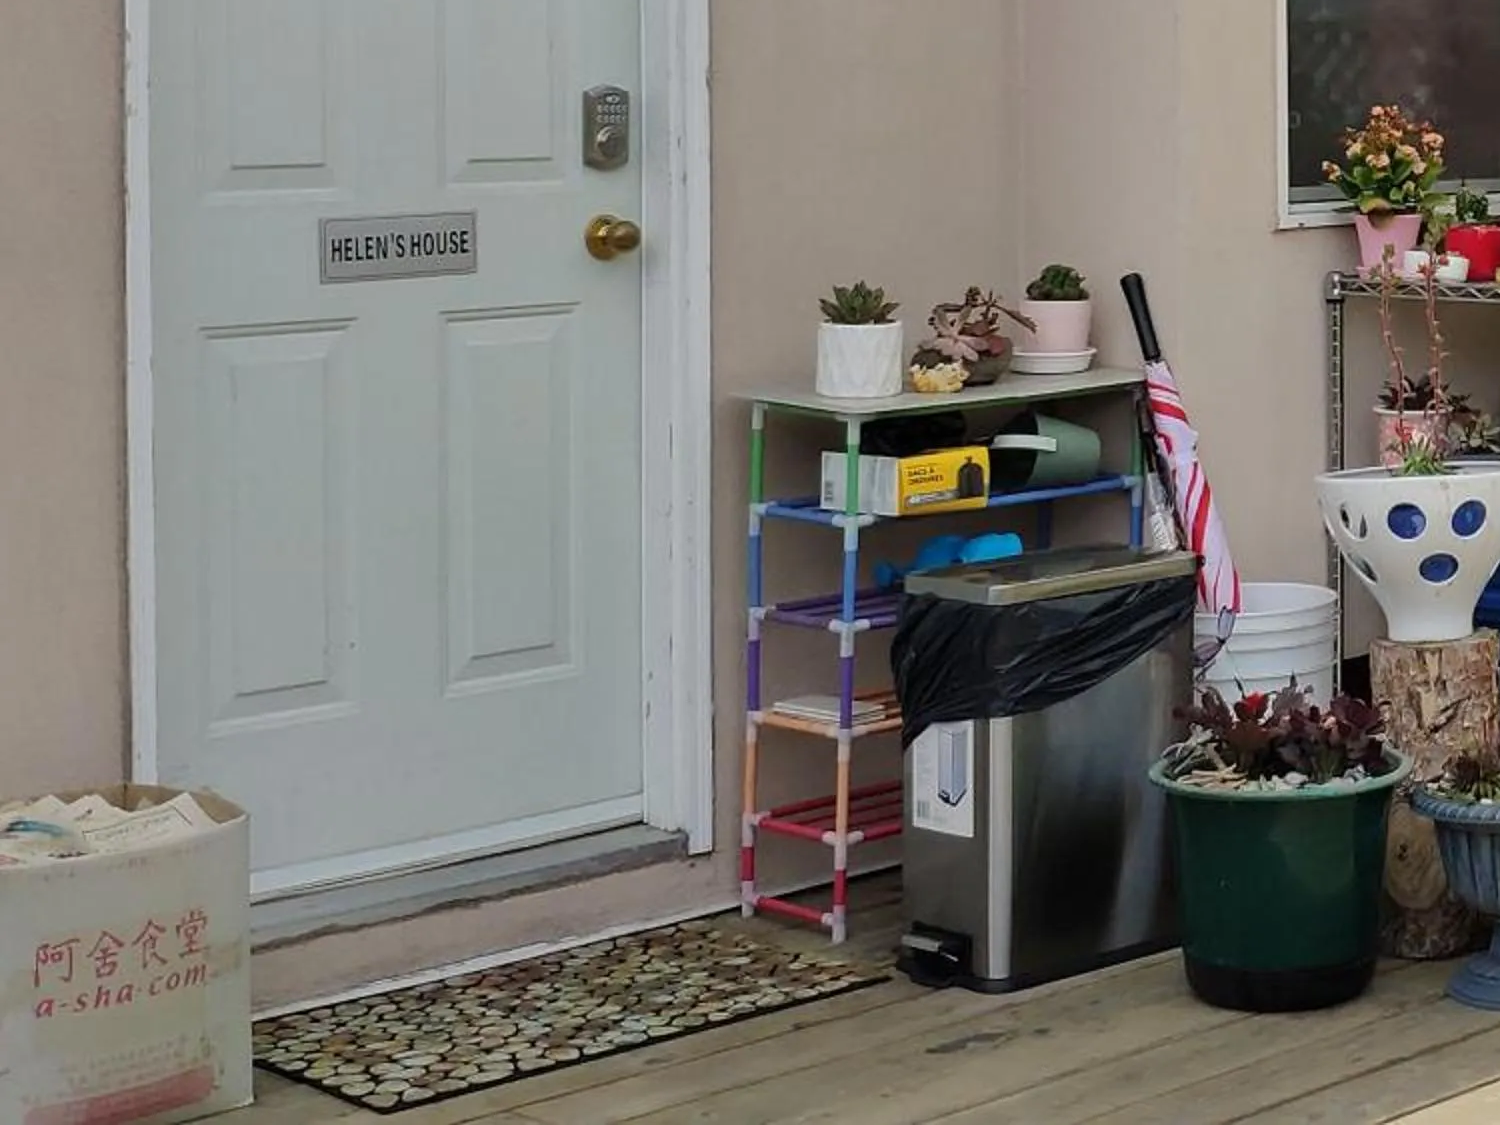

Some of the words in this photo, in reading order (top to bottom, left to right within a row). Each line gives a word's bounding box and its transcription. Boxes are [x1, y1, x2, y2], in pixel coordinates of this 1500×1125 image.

[331, 233, 405, 263] HELEN'S
[410, 230, 470, 257] HOUSE
[33, 908, 210, 988] 阿舍食堂
